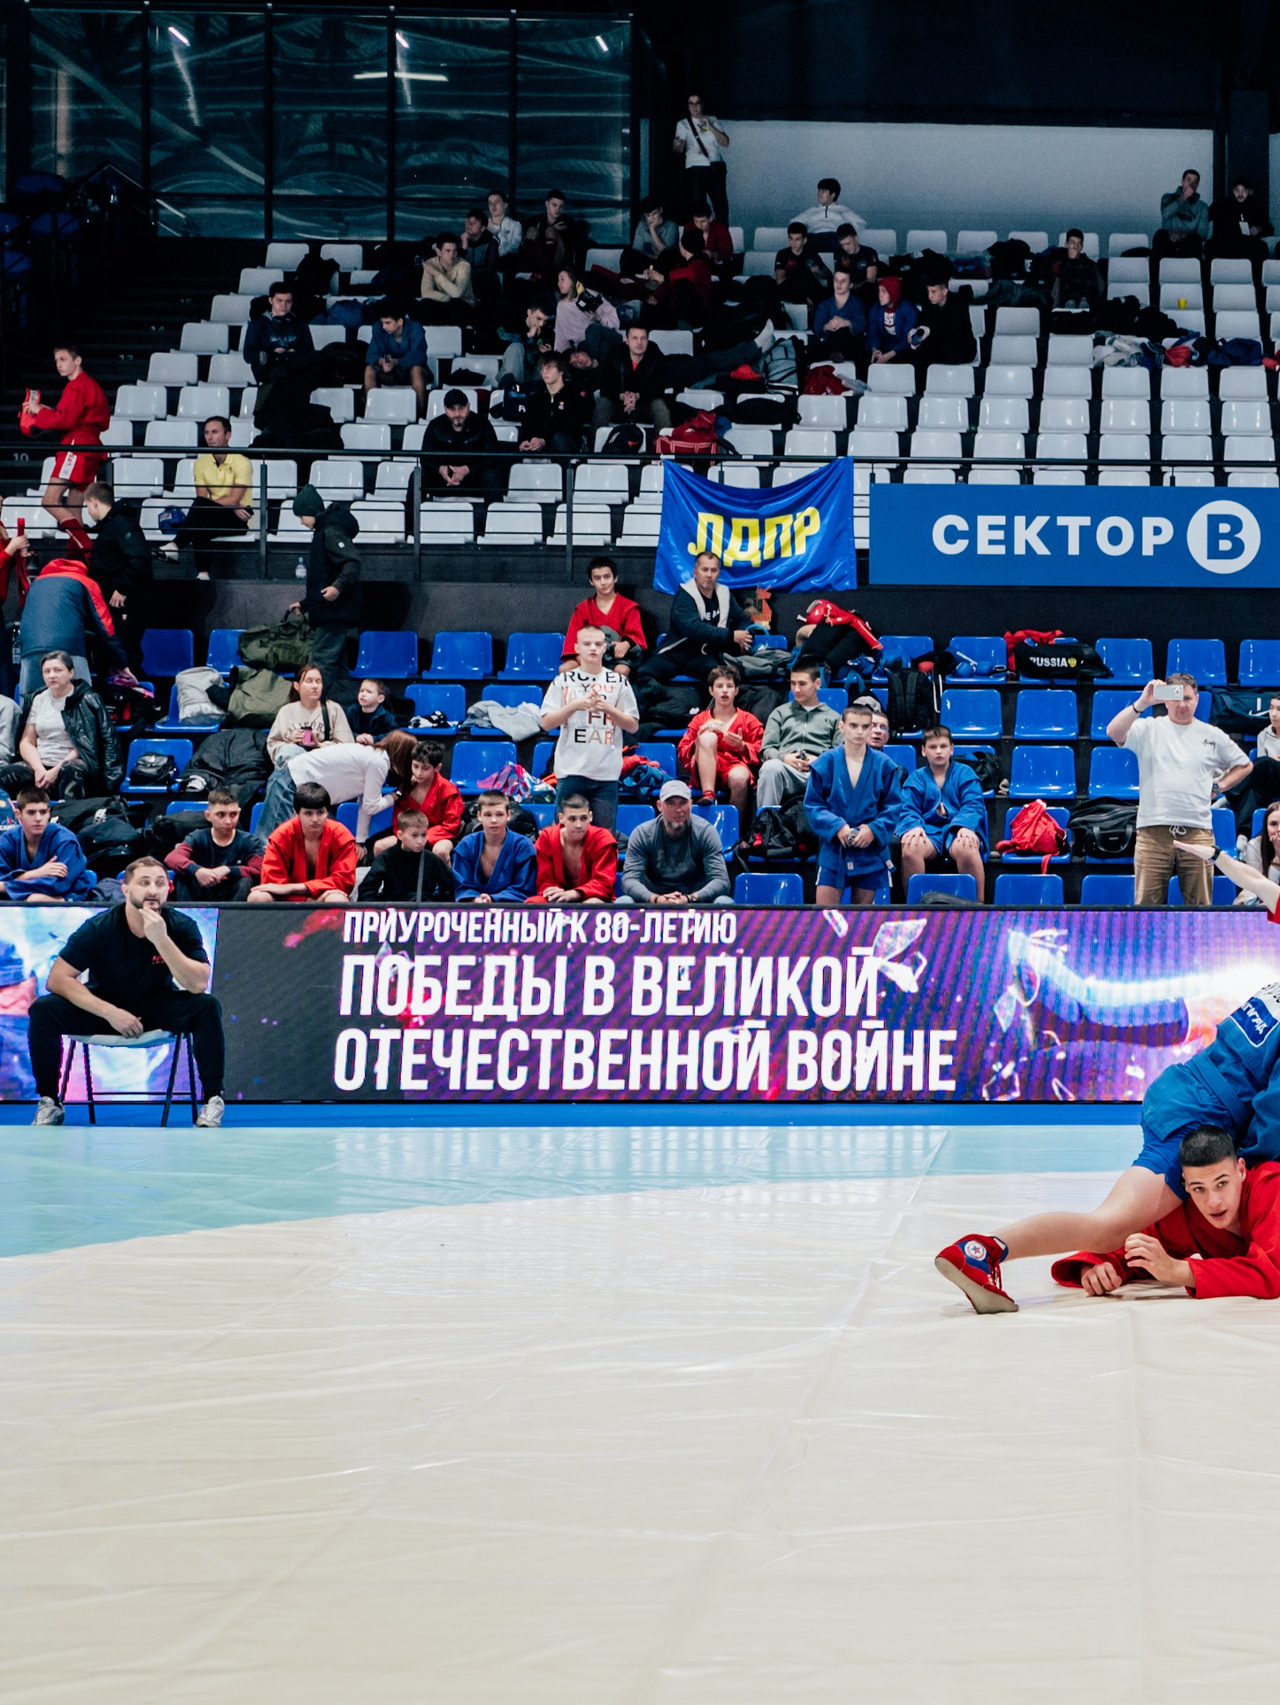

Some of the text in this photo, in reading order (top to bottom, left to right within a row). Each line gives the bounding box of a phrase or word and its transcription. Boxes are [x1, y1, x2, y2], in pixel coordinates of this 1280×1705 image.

[687, 507, 821, 567] ЛДПР
[932, 513, 1246, 560] СЕКТОР В
[343, 909, 737, 943] ПРИУРОЧЕННЫЙ К 80-ЛЕТИЮ
[339, 947, 878, 1021] ПОБЕДЫ В ВЕЛИКОЙ
[334, 1020, 957, 1091] ОТЕЧЕСТВЕННОЙ ВОЙНЕ
